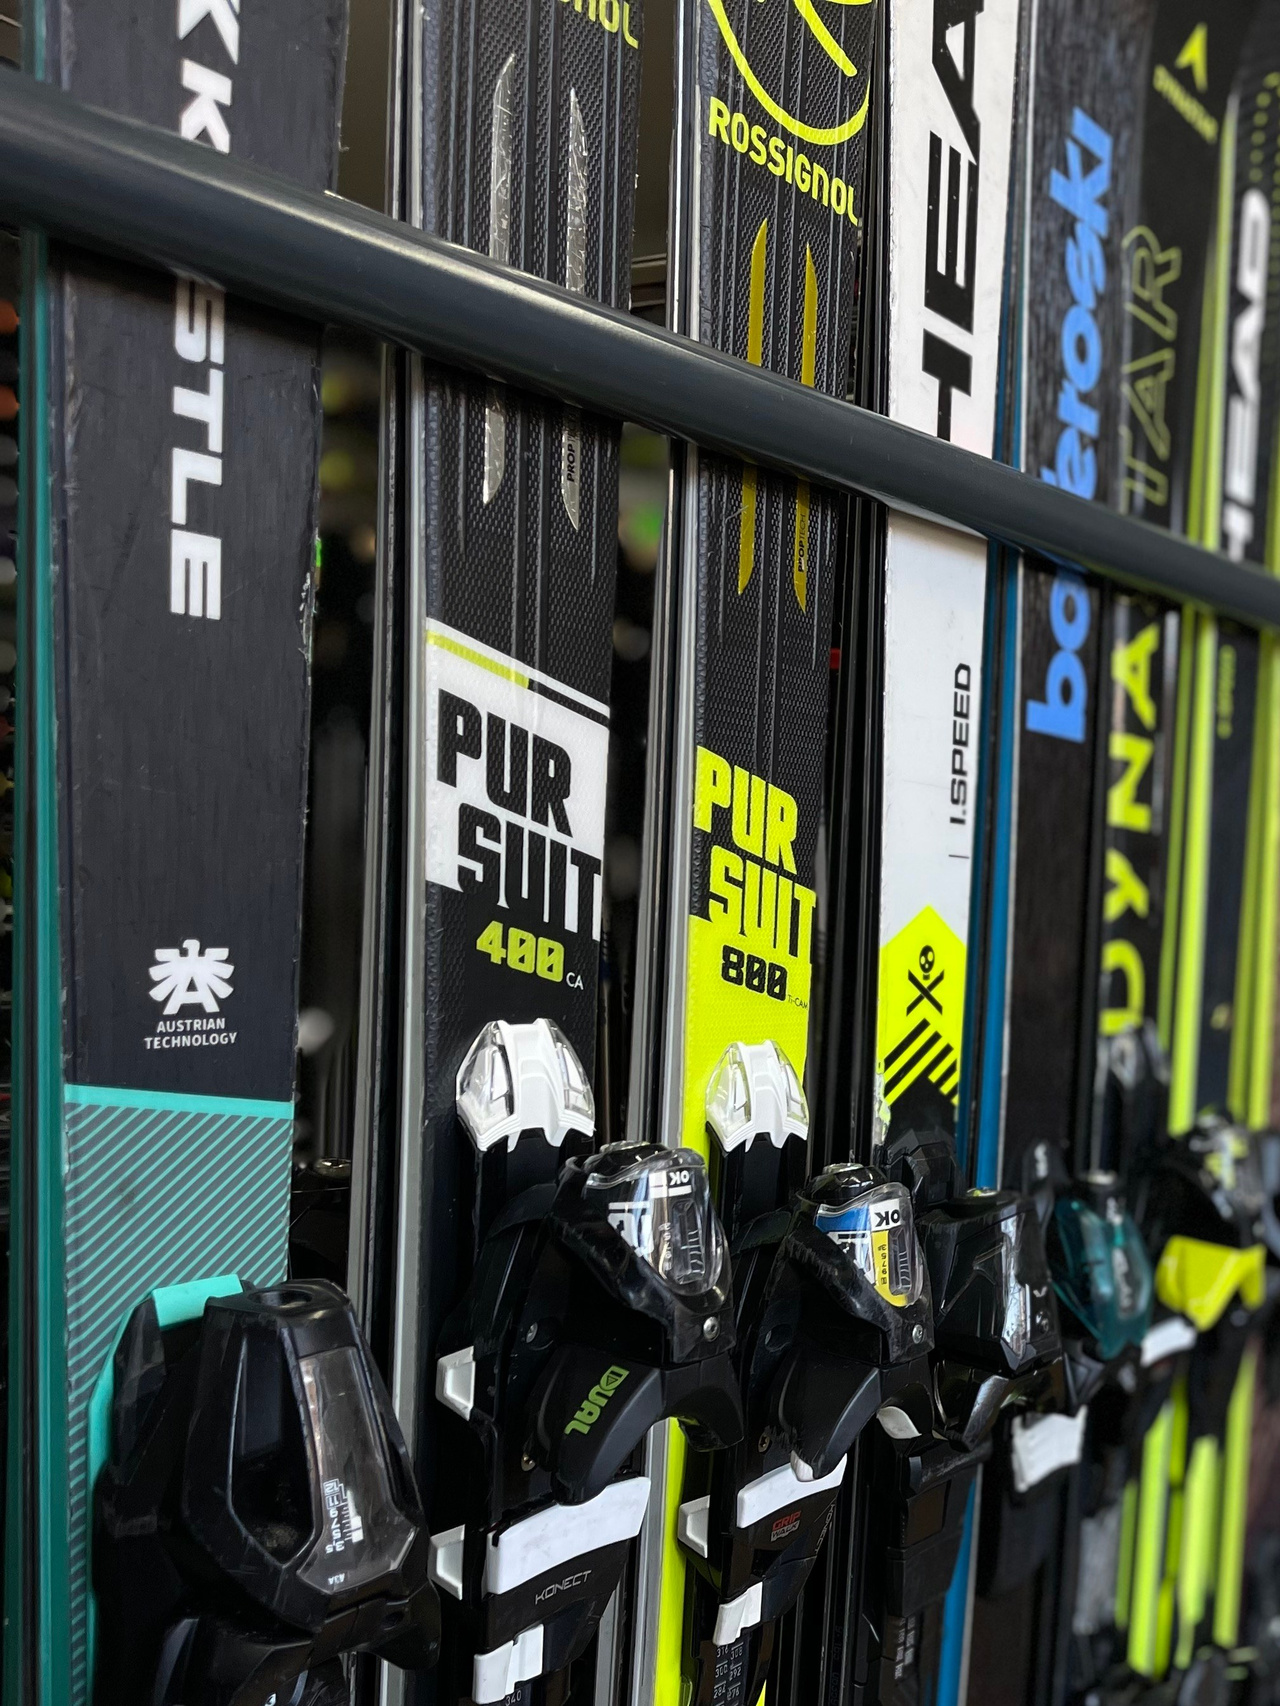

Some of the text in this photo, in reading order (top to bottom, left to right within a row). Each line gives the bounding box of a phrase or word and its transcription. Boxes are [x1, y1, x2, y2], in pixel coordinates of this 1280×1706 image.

[709, 96, 859, 227] ROSSIGNOL
[949, 662, 971, 826] I.SPEED
[437, 687, 573, 838] PUR
[693, 745, 798, 875] PUR
[457, 802, 602, 945] SUIT
[709, 845, 817, 960] SUIT
[476, 920, 584, 990] 400 CA
[721, 945, 787, 1002] 800
[156, 1018, 226, 1033] AUSTRIAN
[143, 1032, 238, 1049] TECHNOLOGY
[669, 1170, 690, 1186] OK
[874, 1209, 900, 1227] OK
[564, 1365, 630, 1435] DUAL
[325, 1480, 339, 1493] 12
[328, 1494, 339, 1506] 11
[329, 1507, 338, 1518] 9
[772, 1510, 801, 1532] GRIP
[331, 1518, 340, 1530] 7
[332, 1529, 342, 1540] 5
[535, 1570, 592, 1605] KONECT
[729, 1666, 742, 1681] 292
